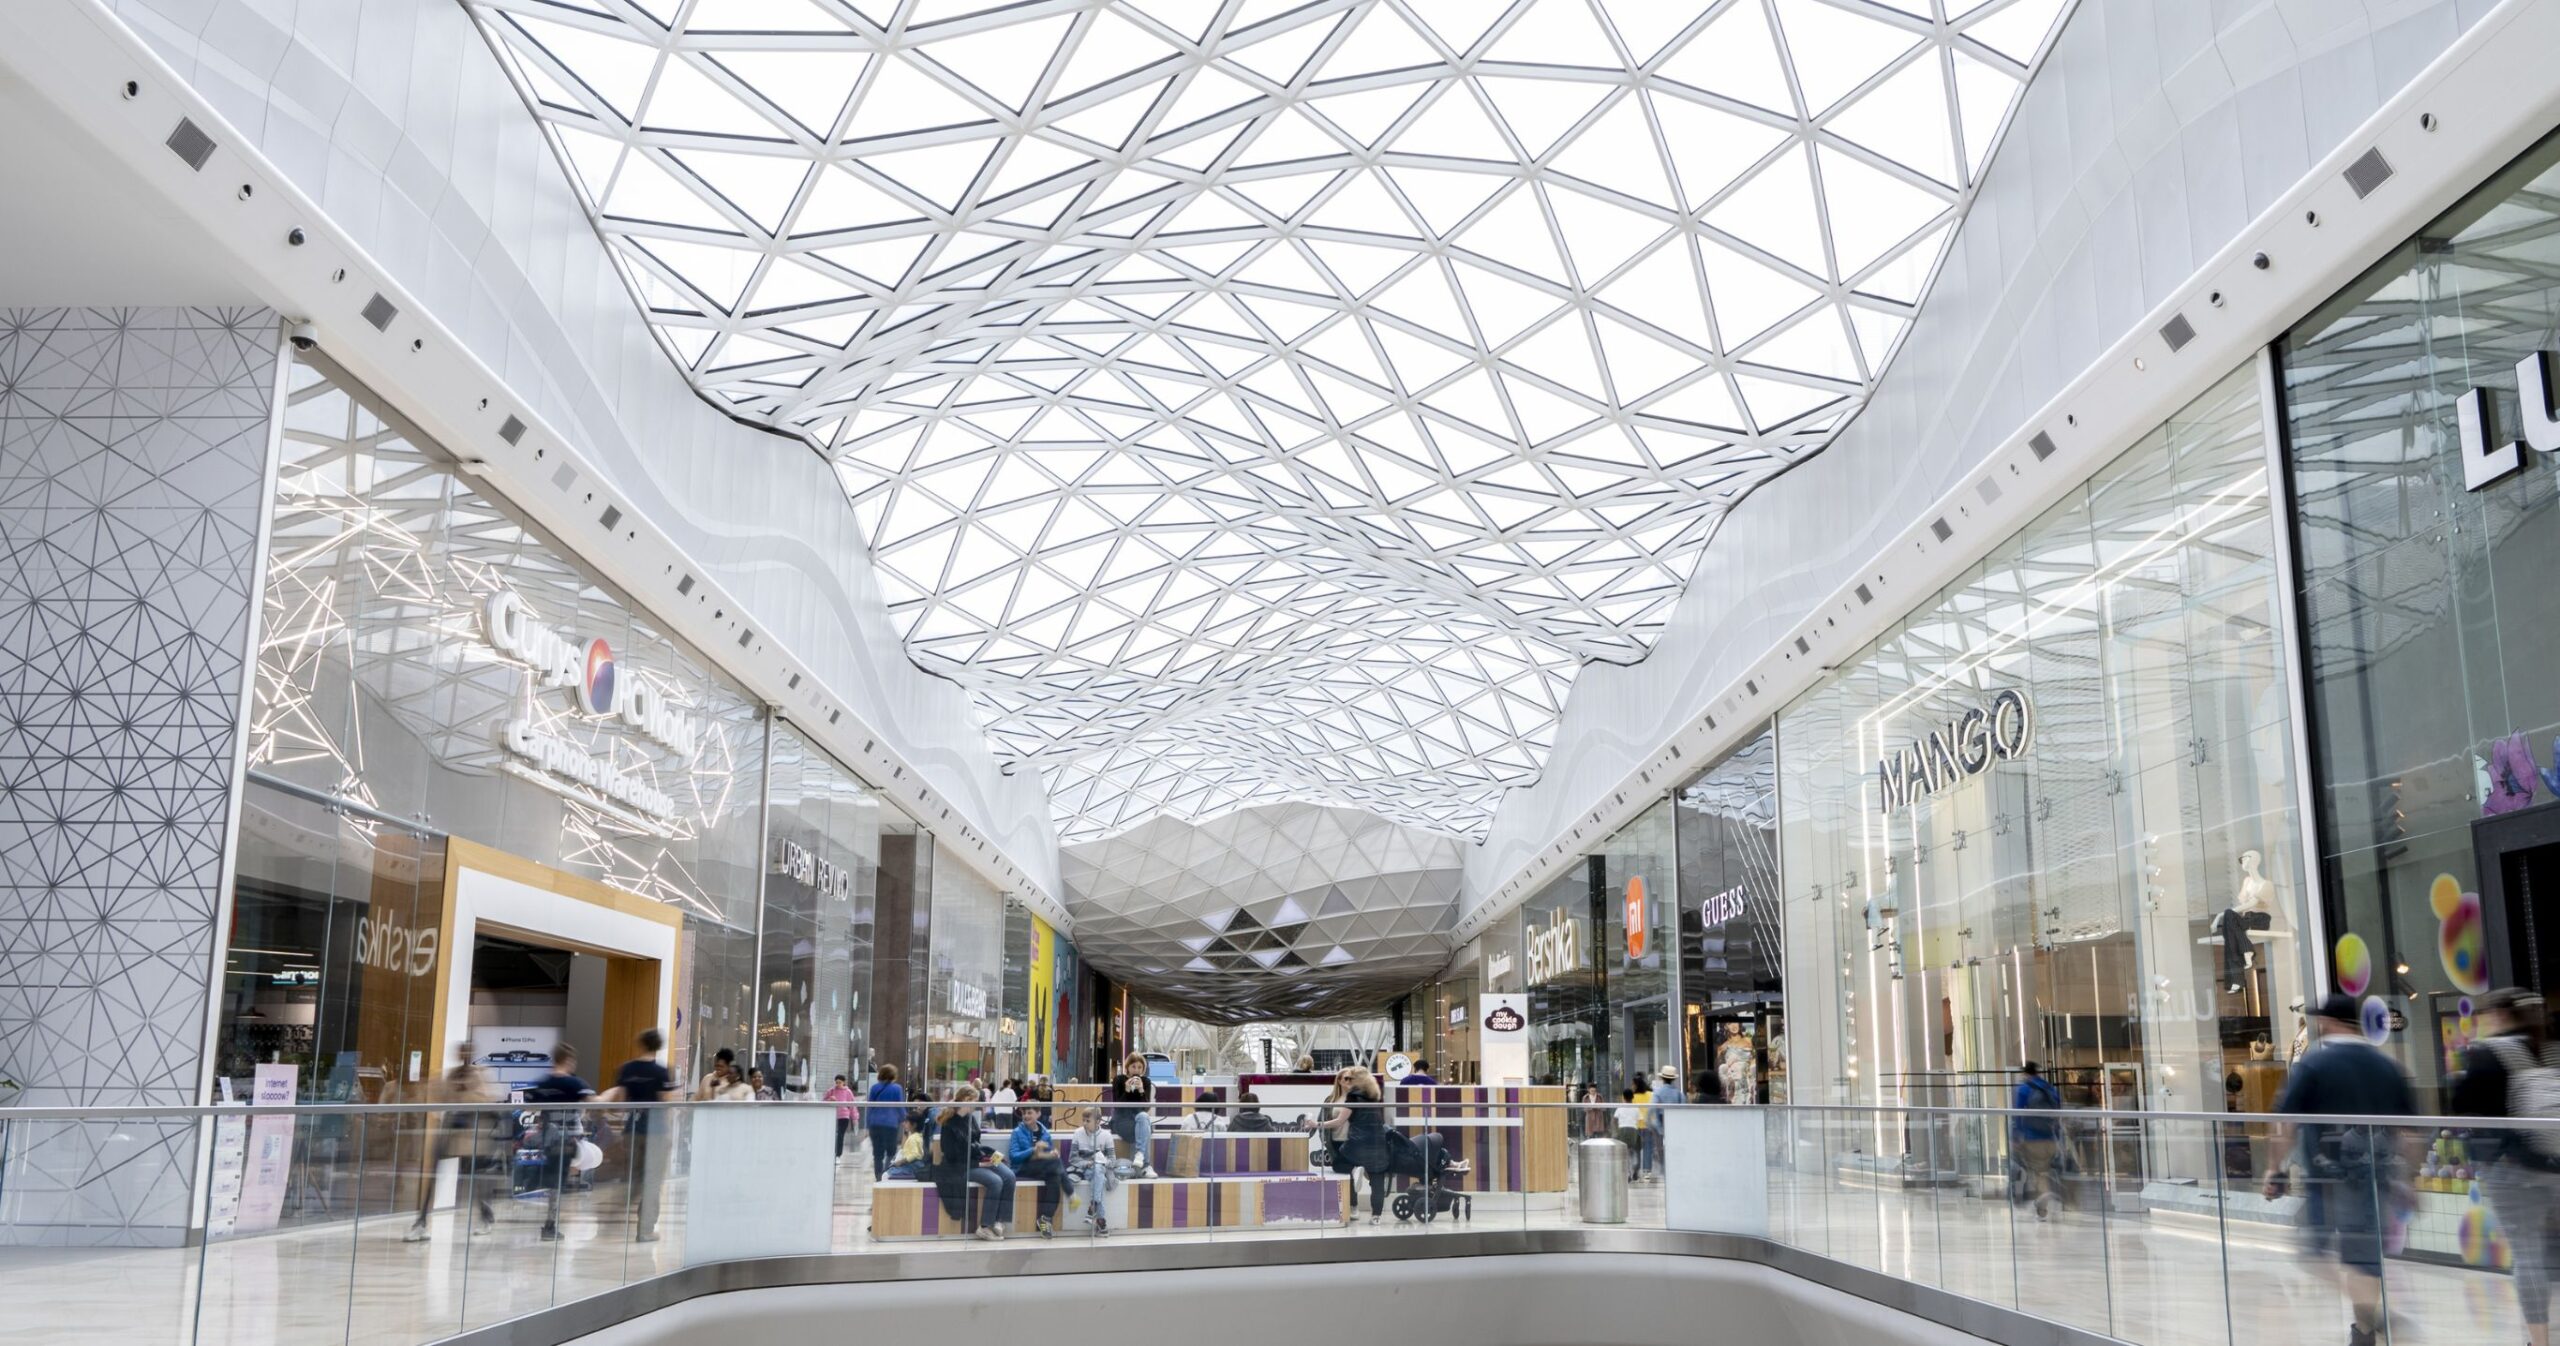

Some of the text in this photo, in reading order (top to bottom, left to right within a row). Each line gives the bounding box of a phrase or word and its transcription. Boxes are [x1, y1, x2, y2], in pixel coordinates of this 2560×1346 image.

[491, 591, 582, 687] Currys
[508, 719, 675, 819] Carphone Warehouse
[1879, 689, 2030, 815] MANGO
[782, 838, 815, 887] URBAN
[1702, 884, 1745, 928] GUESS
[1526, 906, 1574, 986] Bershka
[1492, 1016, 1518, 1024] cookie
[1492, 1022, 1517, 1031] dough
[1495, 1011, 1508, 1019] my
